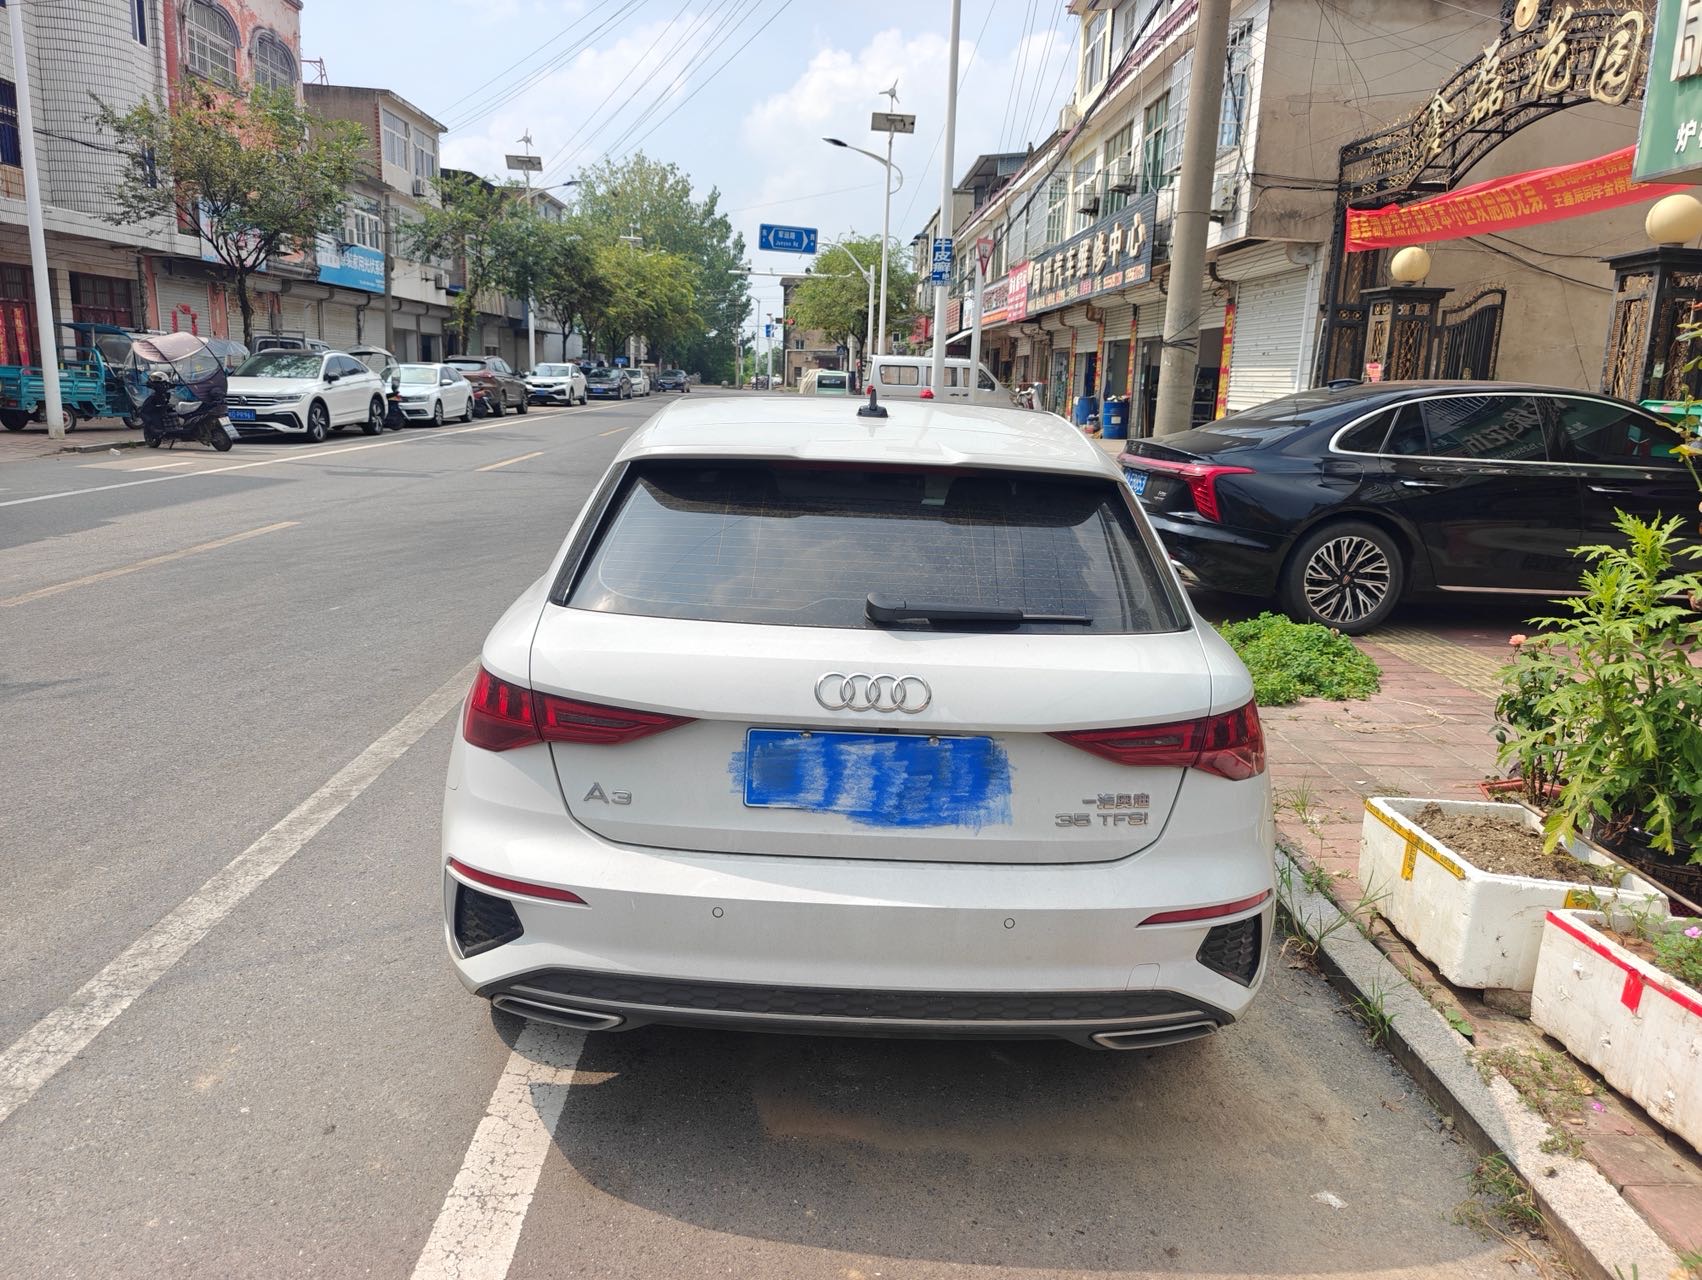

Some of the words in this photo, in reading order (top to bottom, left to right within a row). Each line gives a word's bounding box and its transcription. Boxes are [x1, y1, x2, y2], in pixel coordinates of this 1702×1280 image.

[583, 782, 633, 805] A3
[1081, 792, 1150, 809] 一汽奥迪
[1055, 812, 1091, 827] 35
[1097, 811, 1149, 826] TFSI
